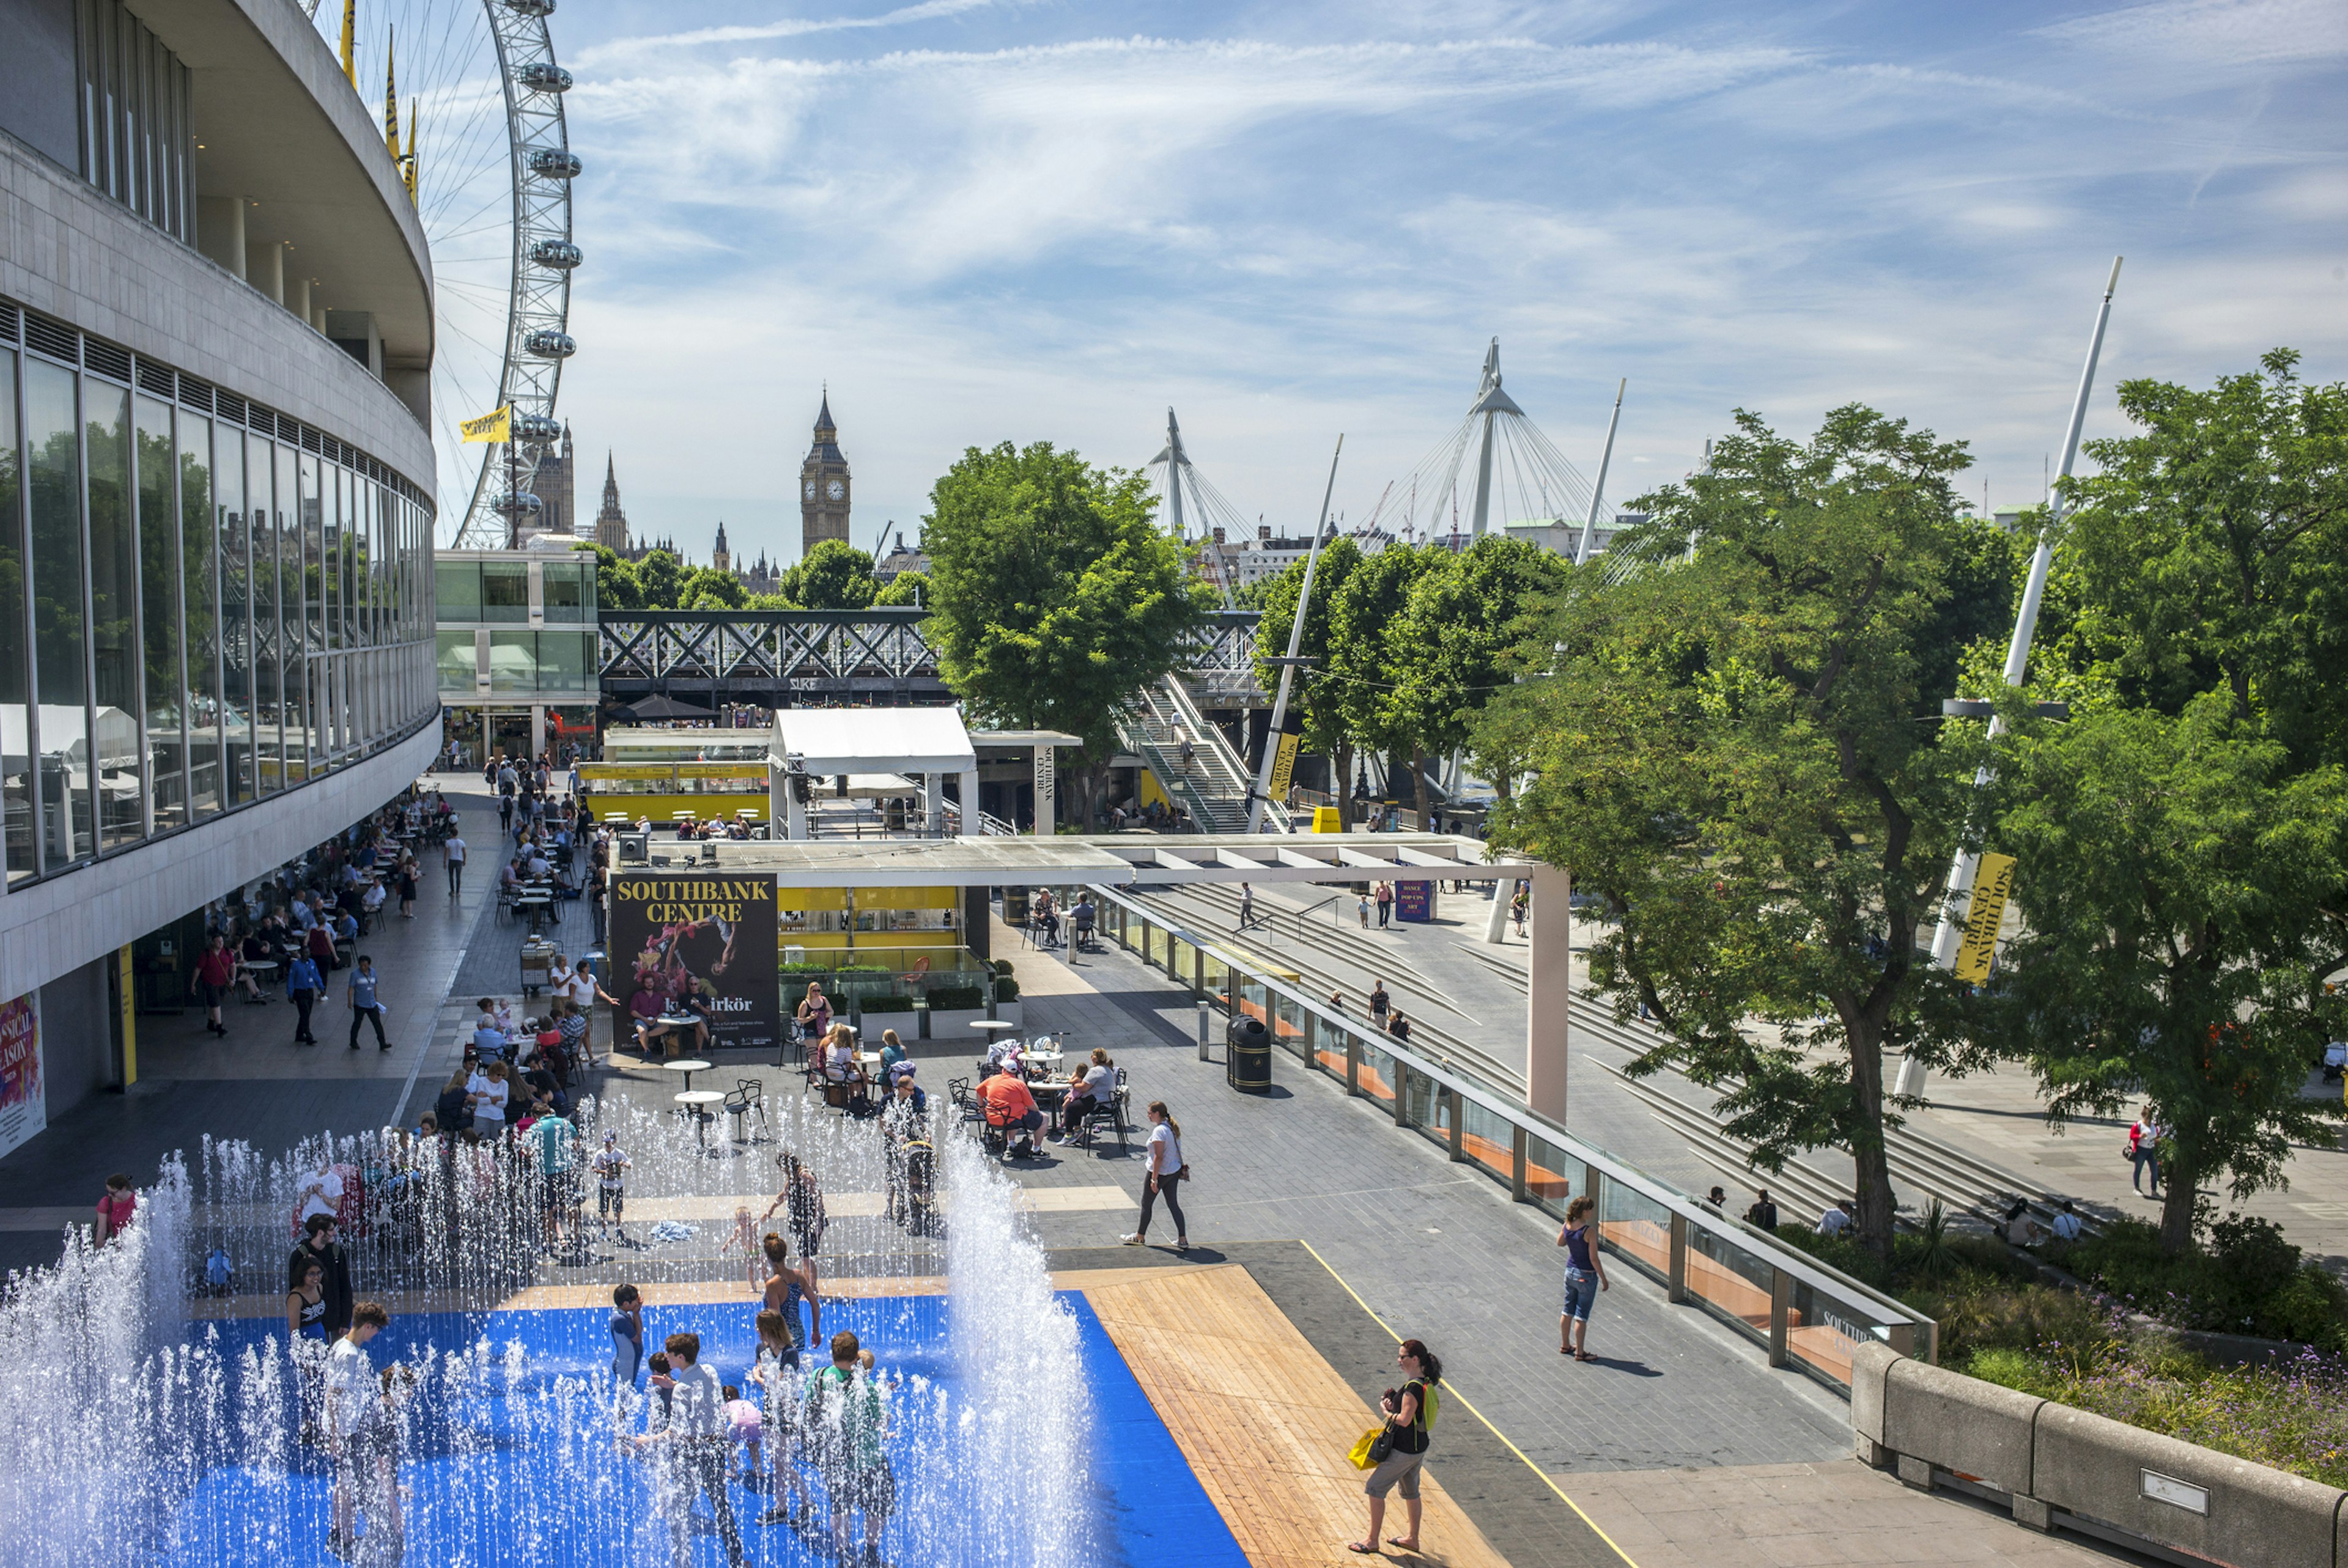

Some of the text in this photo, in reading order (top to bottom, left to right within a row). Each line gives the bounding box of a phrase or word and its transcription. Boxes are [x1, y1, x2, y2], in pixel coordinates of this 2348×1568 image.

[1274, 751, 1286, 783] CENTRE
[1279, 743, 1295, 794] SOUTHBANK
[618, 881, 769, 901] SOUTHBANK
[646, 903, 742, 923] CENTRE
[1965, 886, 1990, 950] CENTRE
[1974, 870, 2007, 971] SOUTHBANK
[711, 996, 753, 1012] irkör
[0, 1012, 32, 1042] SSICAL
[1824, 1311, 1874, 1344] SOUTHB
